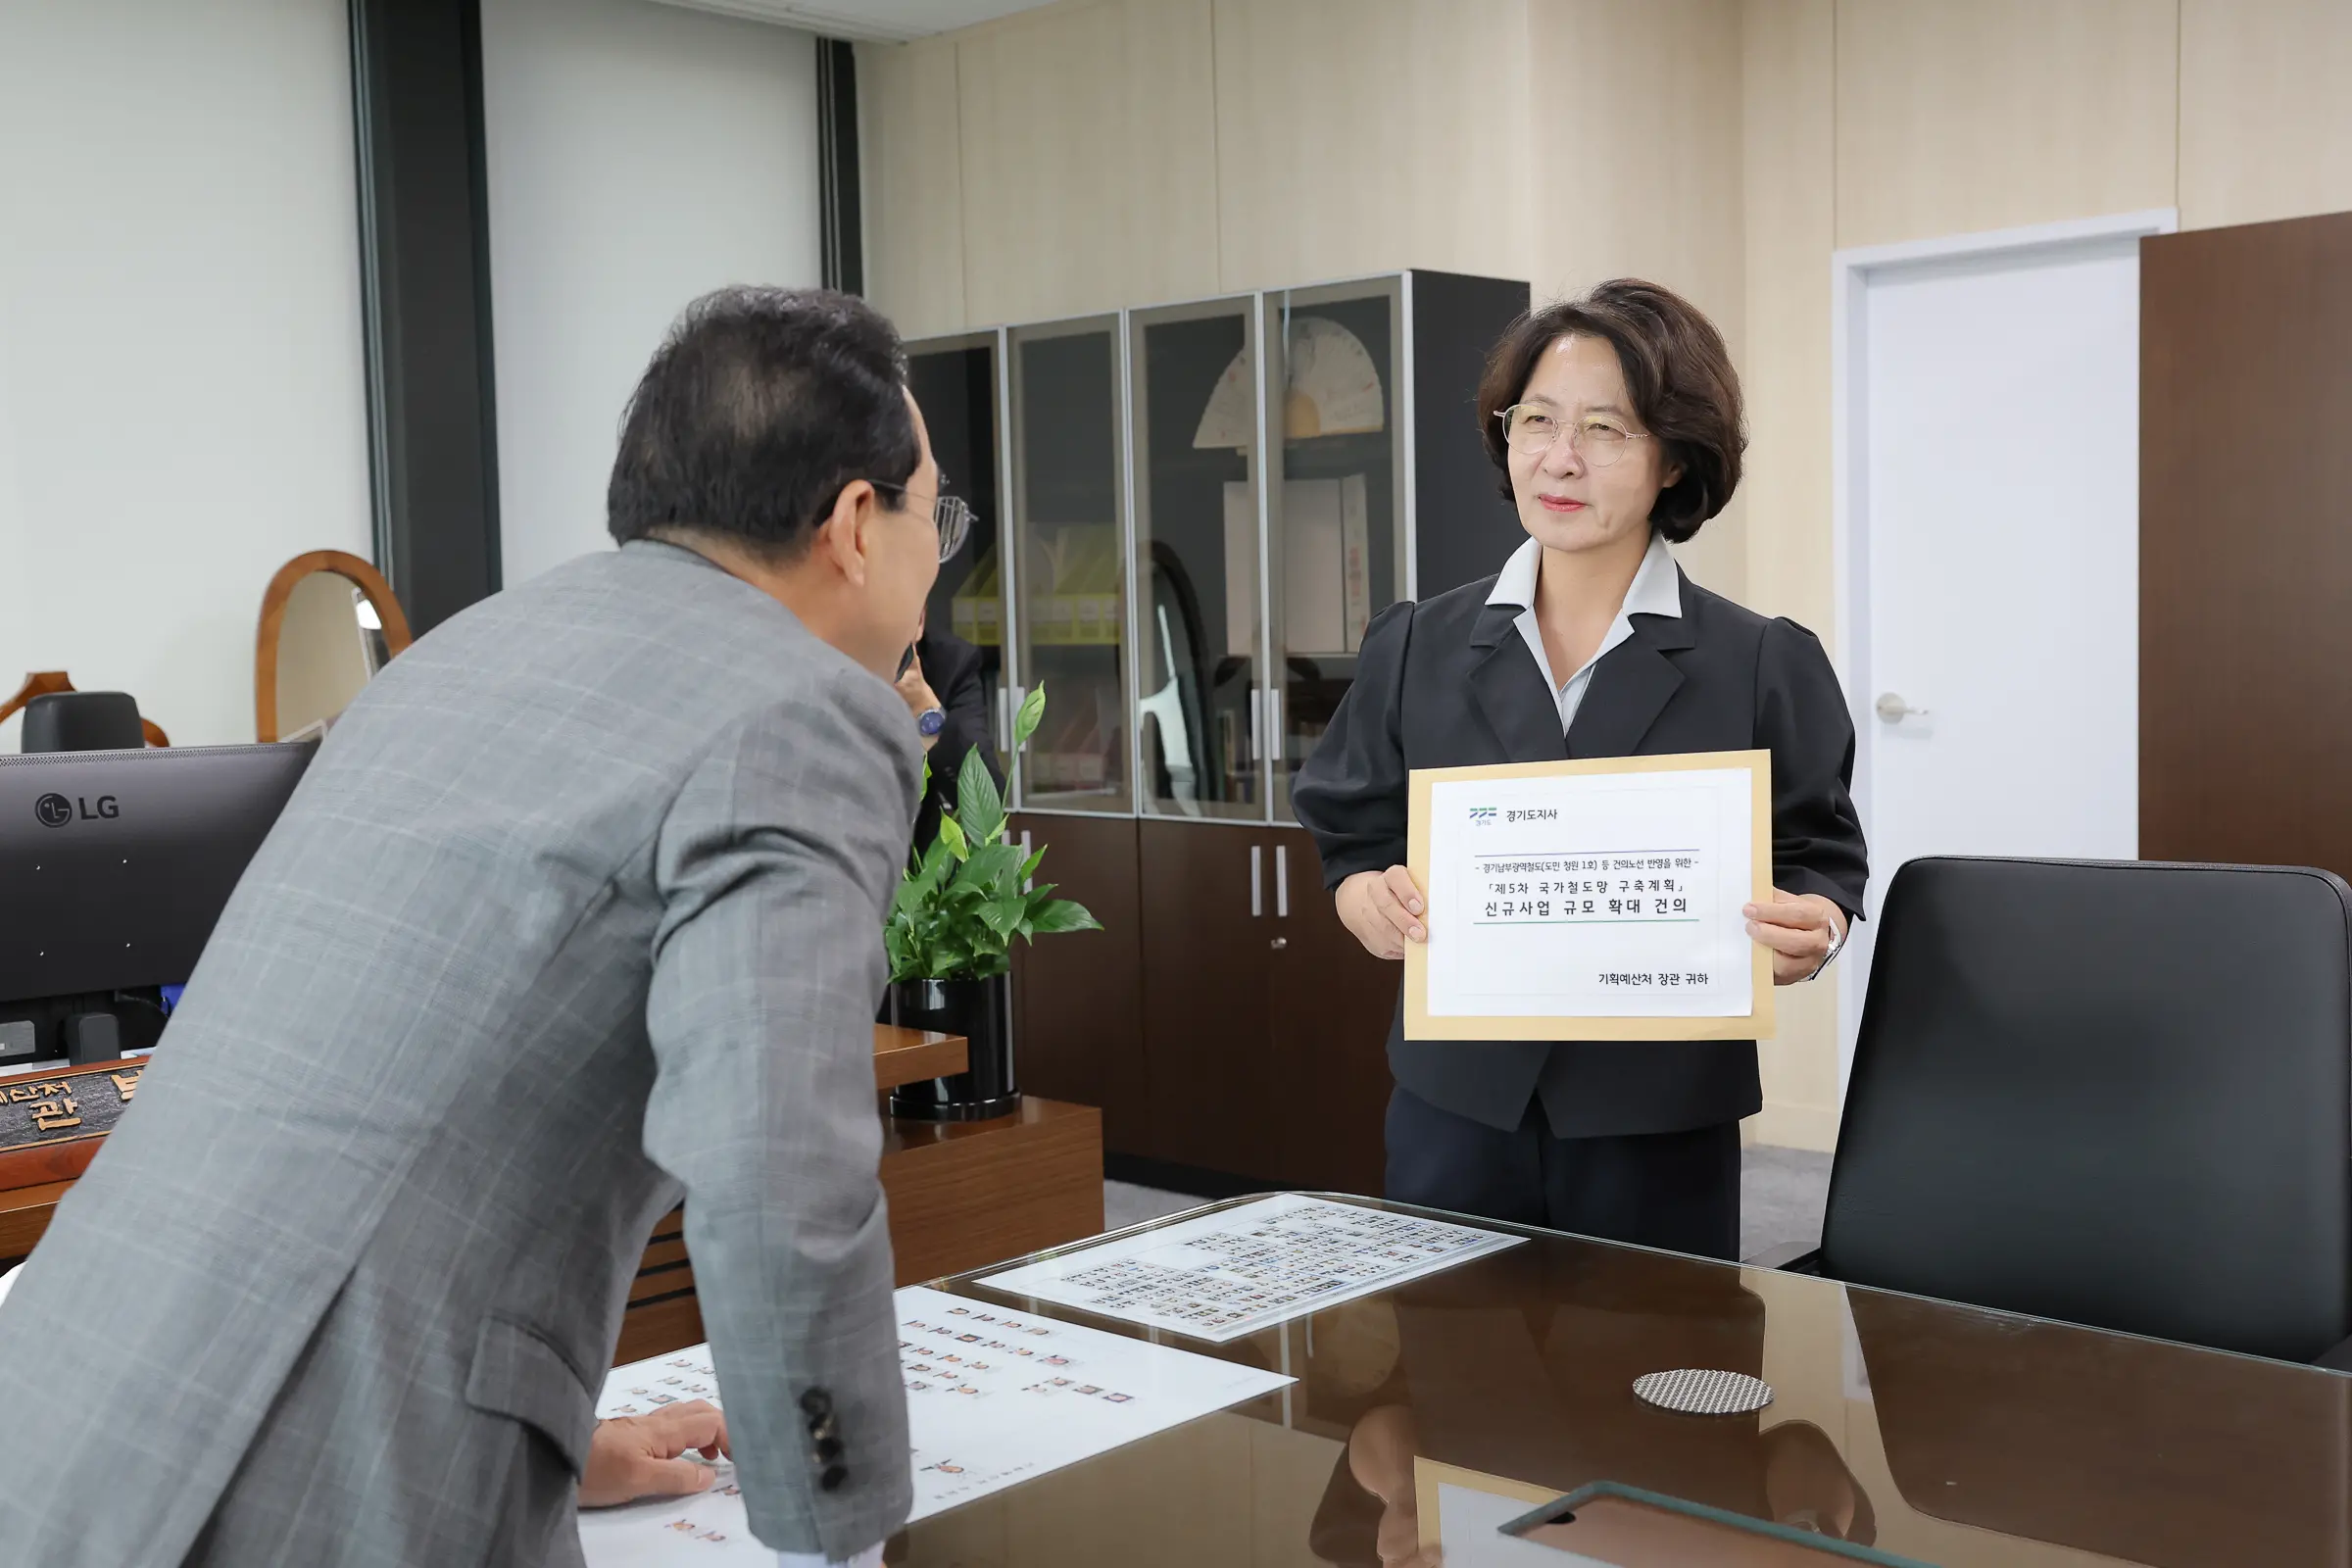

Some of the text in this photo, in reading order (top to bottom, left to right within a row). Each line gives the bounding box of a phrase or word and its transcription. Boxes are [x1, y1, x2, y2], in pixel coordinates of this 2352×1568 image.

[78, 795, 120, 820] LG
[1506, 808, 1558, 822] 경기도지사
[1582, 859, 1597, 871] 1호)
[1601, 859, 1610, 870] 등
[1613, 858, 1644, 870] 건의노선
[1647, 858, 1671, 869] 반영을
[1675, 857, 1691, 868] 위한
[1539, 880, 1608, 895] 국가철도망
[1485, 898, 1687, 917] 신규사업 규모 확대 건의
[1598, 972, 1709, 986] 기획예산처 장관 귀하
